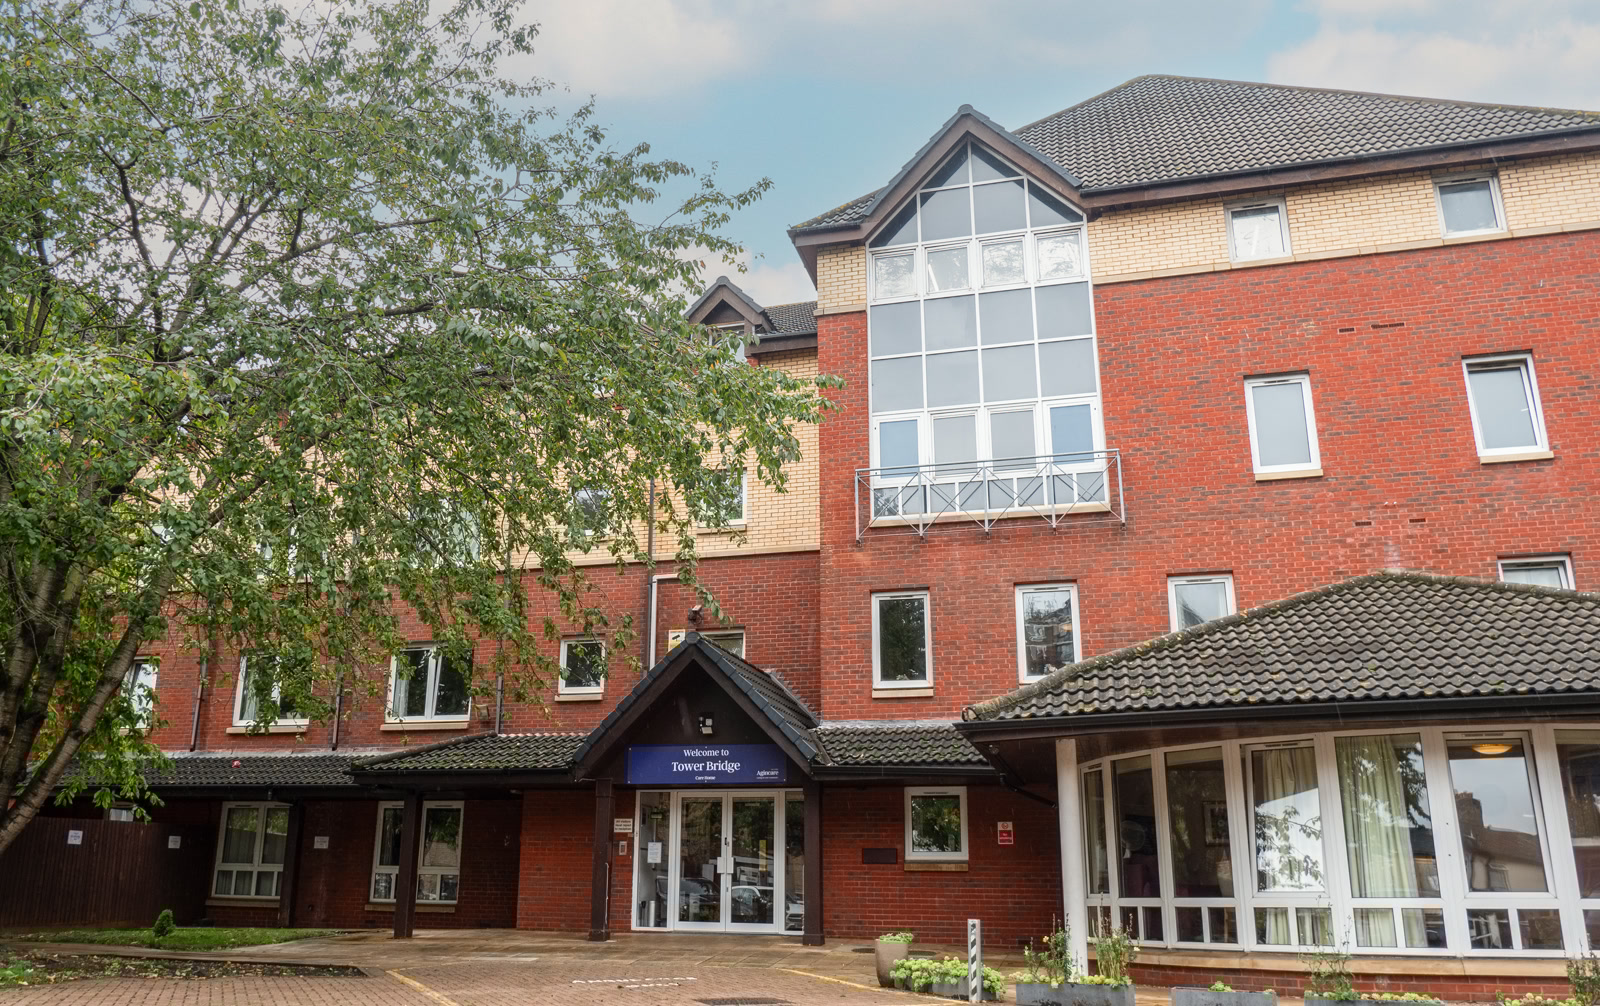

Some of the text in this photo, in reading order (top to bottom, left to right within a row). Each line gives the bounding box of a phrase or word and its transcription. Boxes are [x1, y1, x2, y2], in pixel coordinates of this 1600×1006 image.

[683, 748, 730, 757] Welcome to
[671, 760, 741, 773] Tower Bridge
